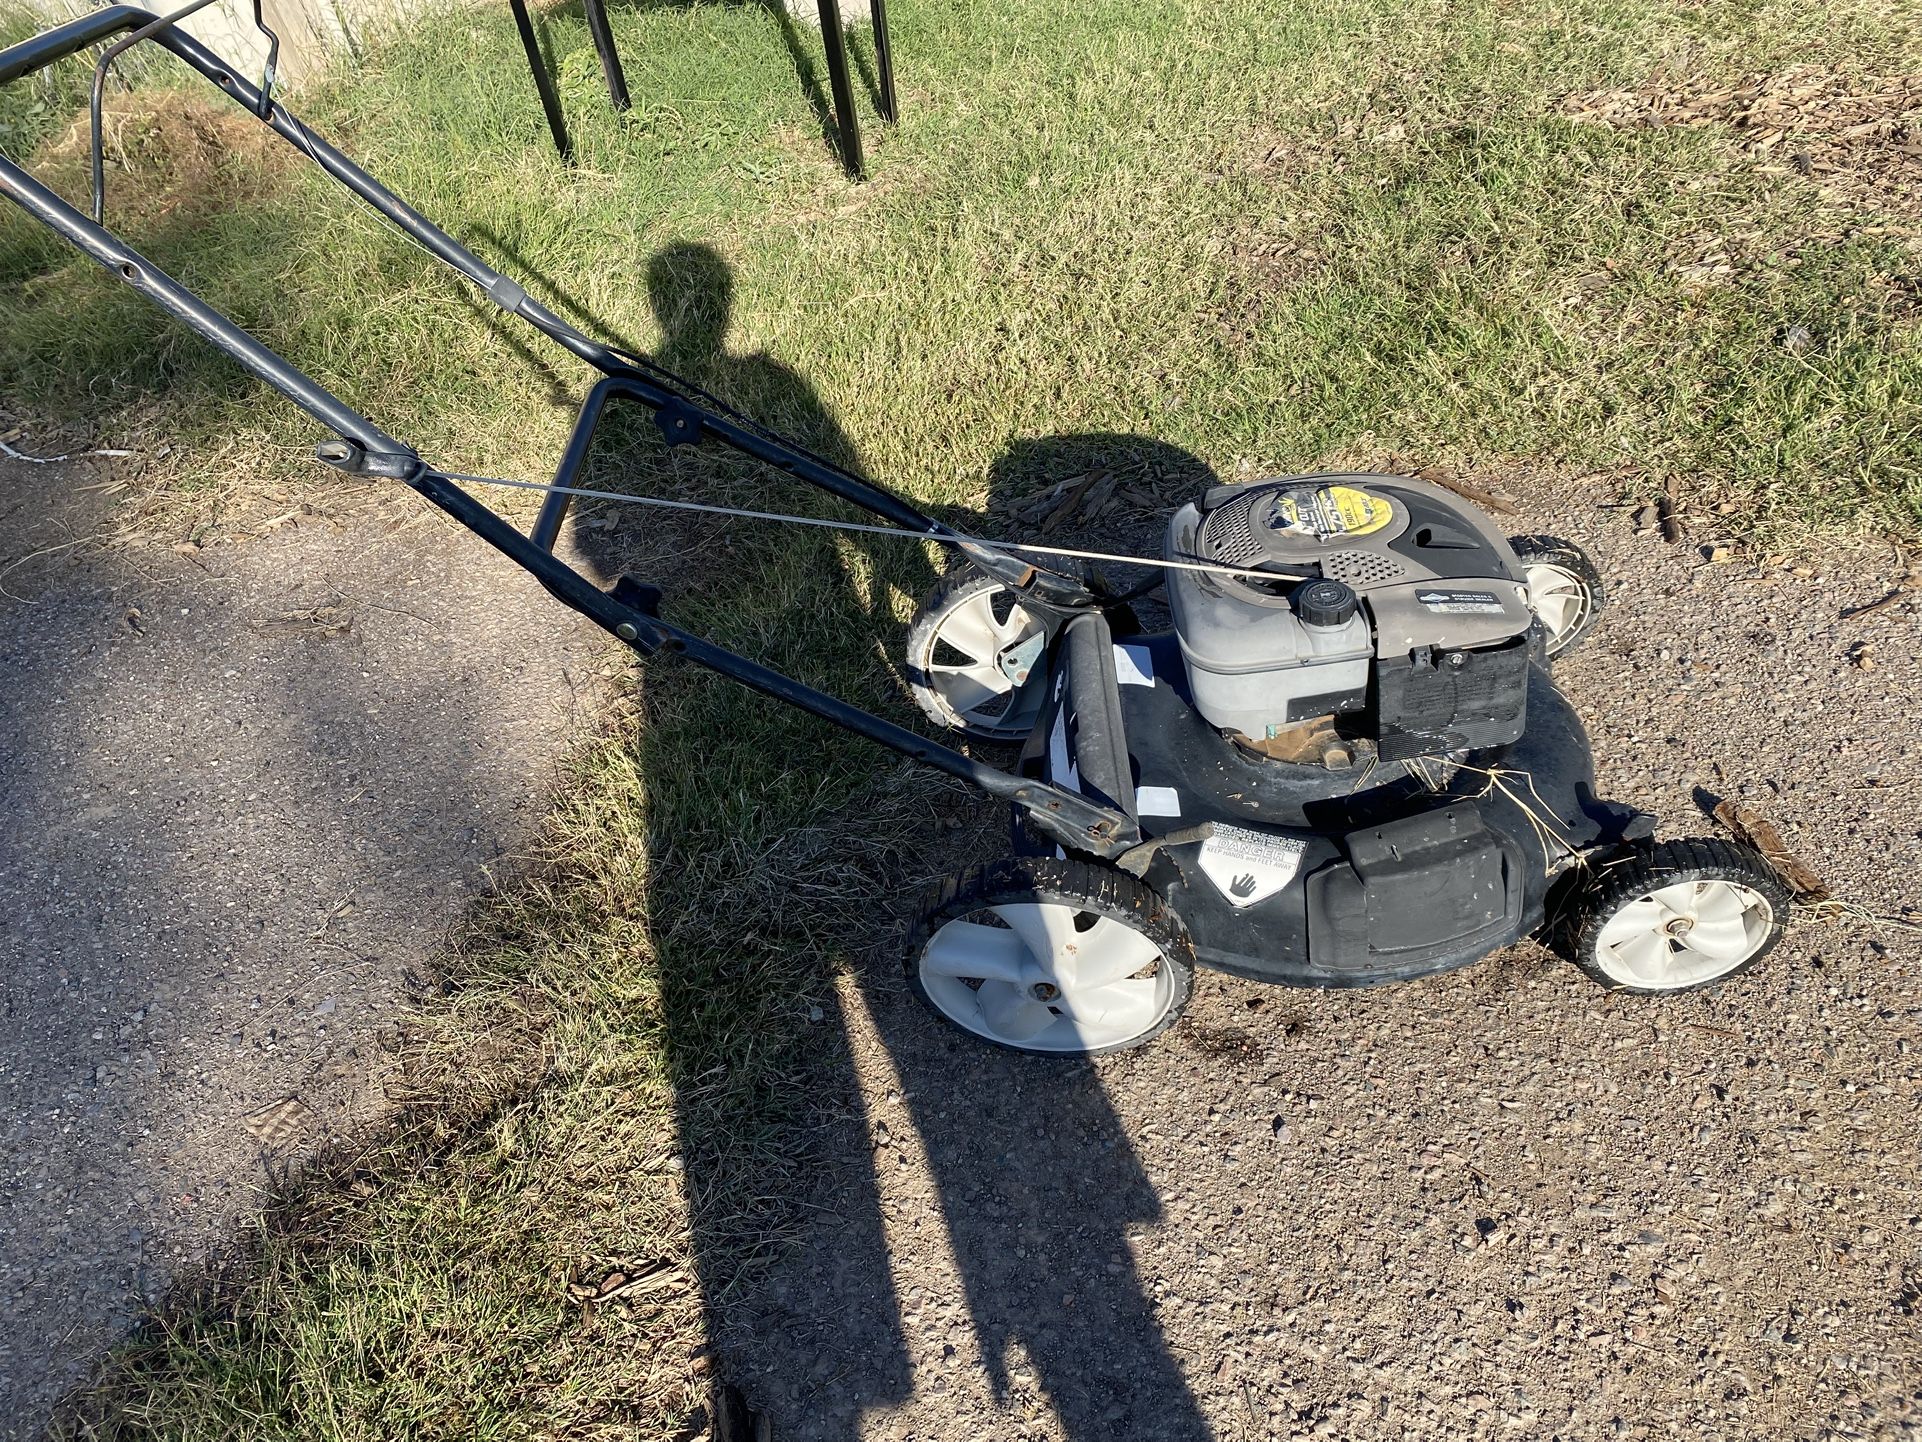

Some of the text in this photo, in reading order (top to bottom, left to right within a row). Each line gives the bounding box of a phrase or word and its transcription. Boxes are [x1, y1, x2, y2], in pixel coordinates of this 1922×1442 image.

[1207, 847, 1222, 855] KEEP
[1223, 850, 1245, 860] HANDS
[1274, 862, 1292, 871] AWAY
[1218, 839, 1285, 861] DANGER
